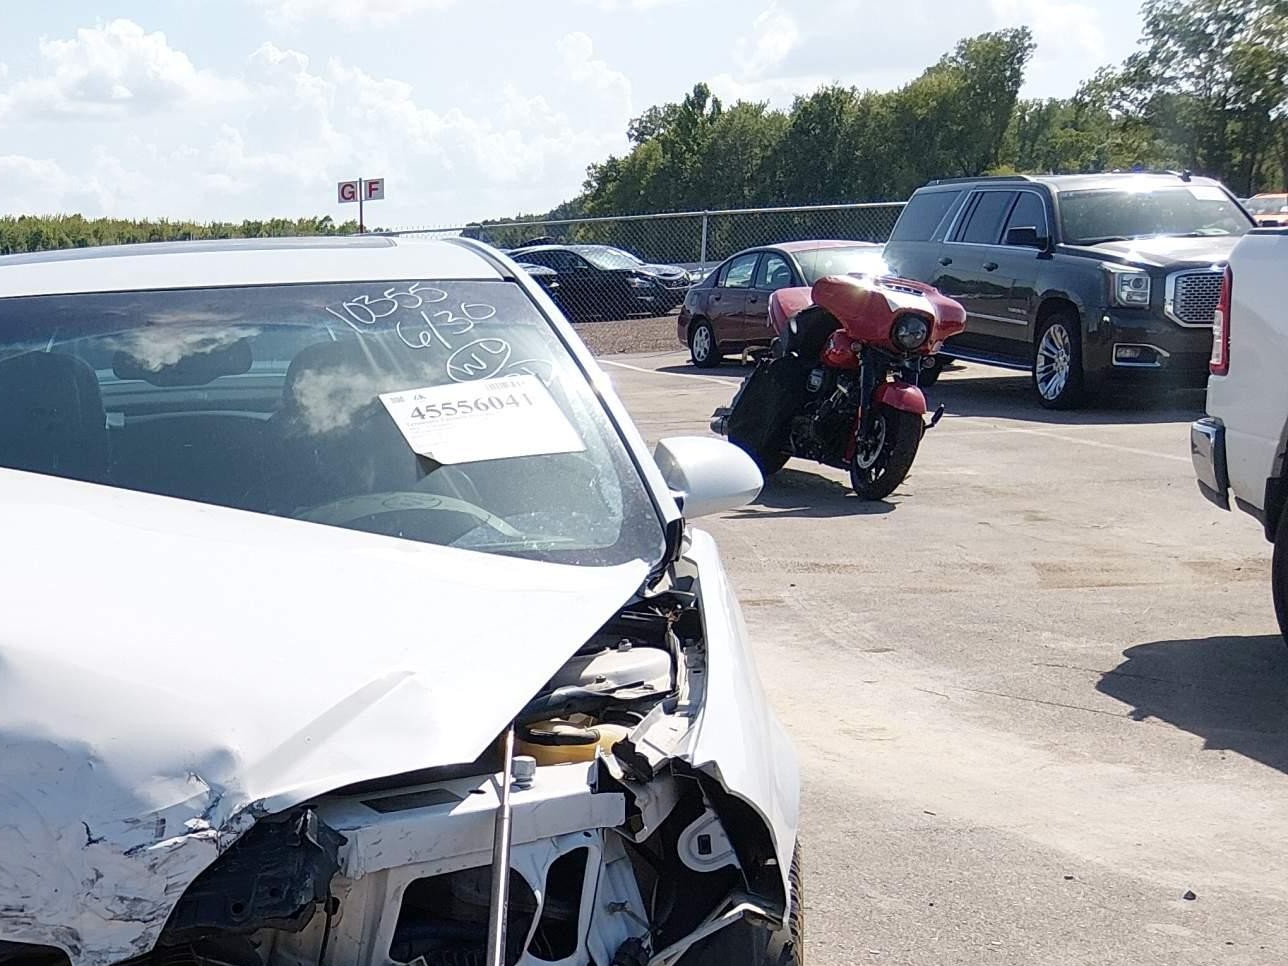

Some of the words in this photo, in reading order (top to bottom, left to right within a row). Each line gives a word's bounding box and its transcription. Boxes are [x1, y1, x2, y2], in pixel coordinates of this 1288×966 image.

[340, 183, 356, 201] G
[368, 181, 380, 199] F
[396, 302, 497, 350] 6/30
[409, 392, 535, 421] 45556041
